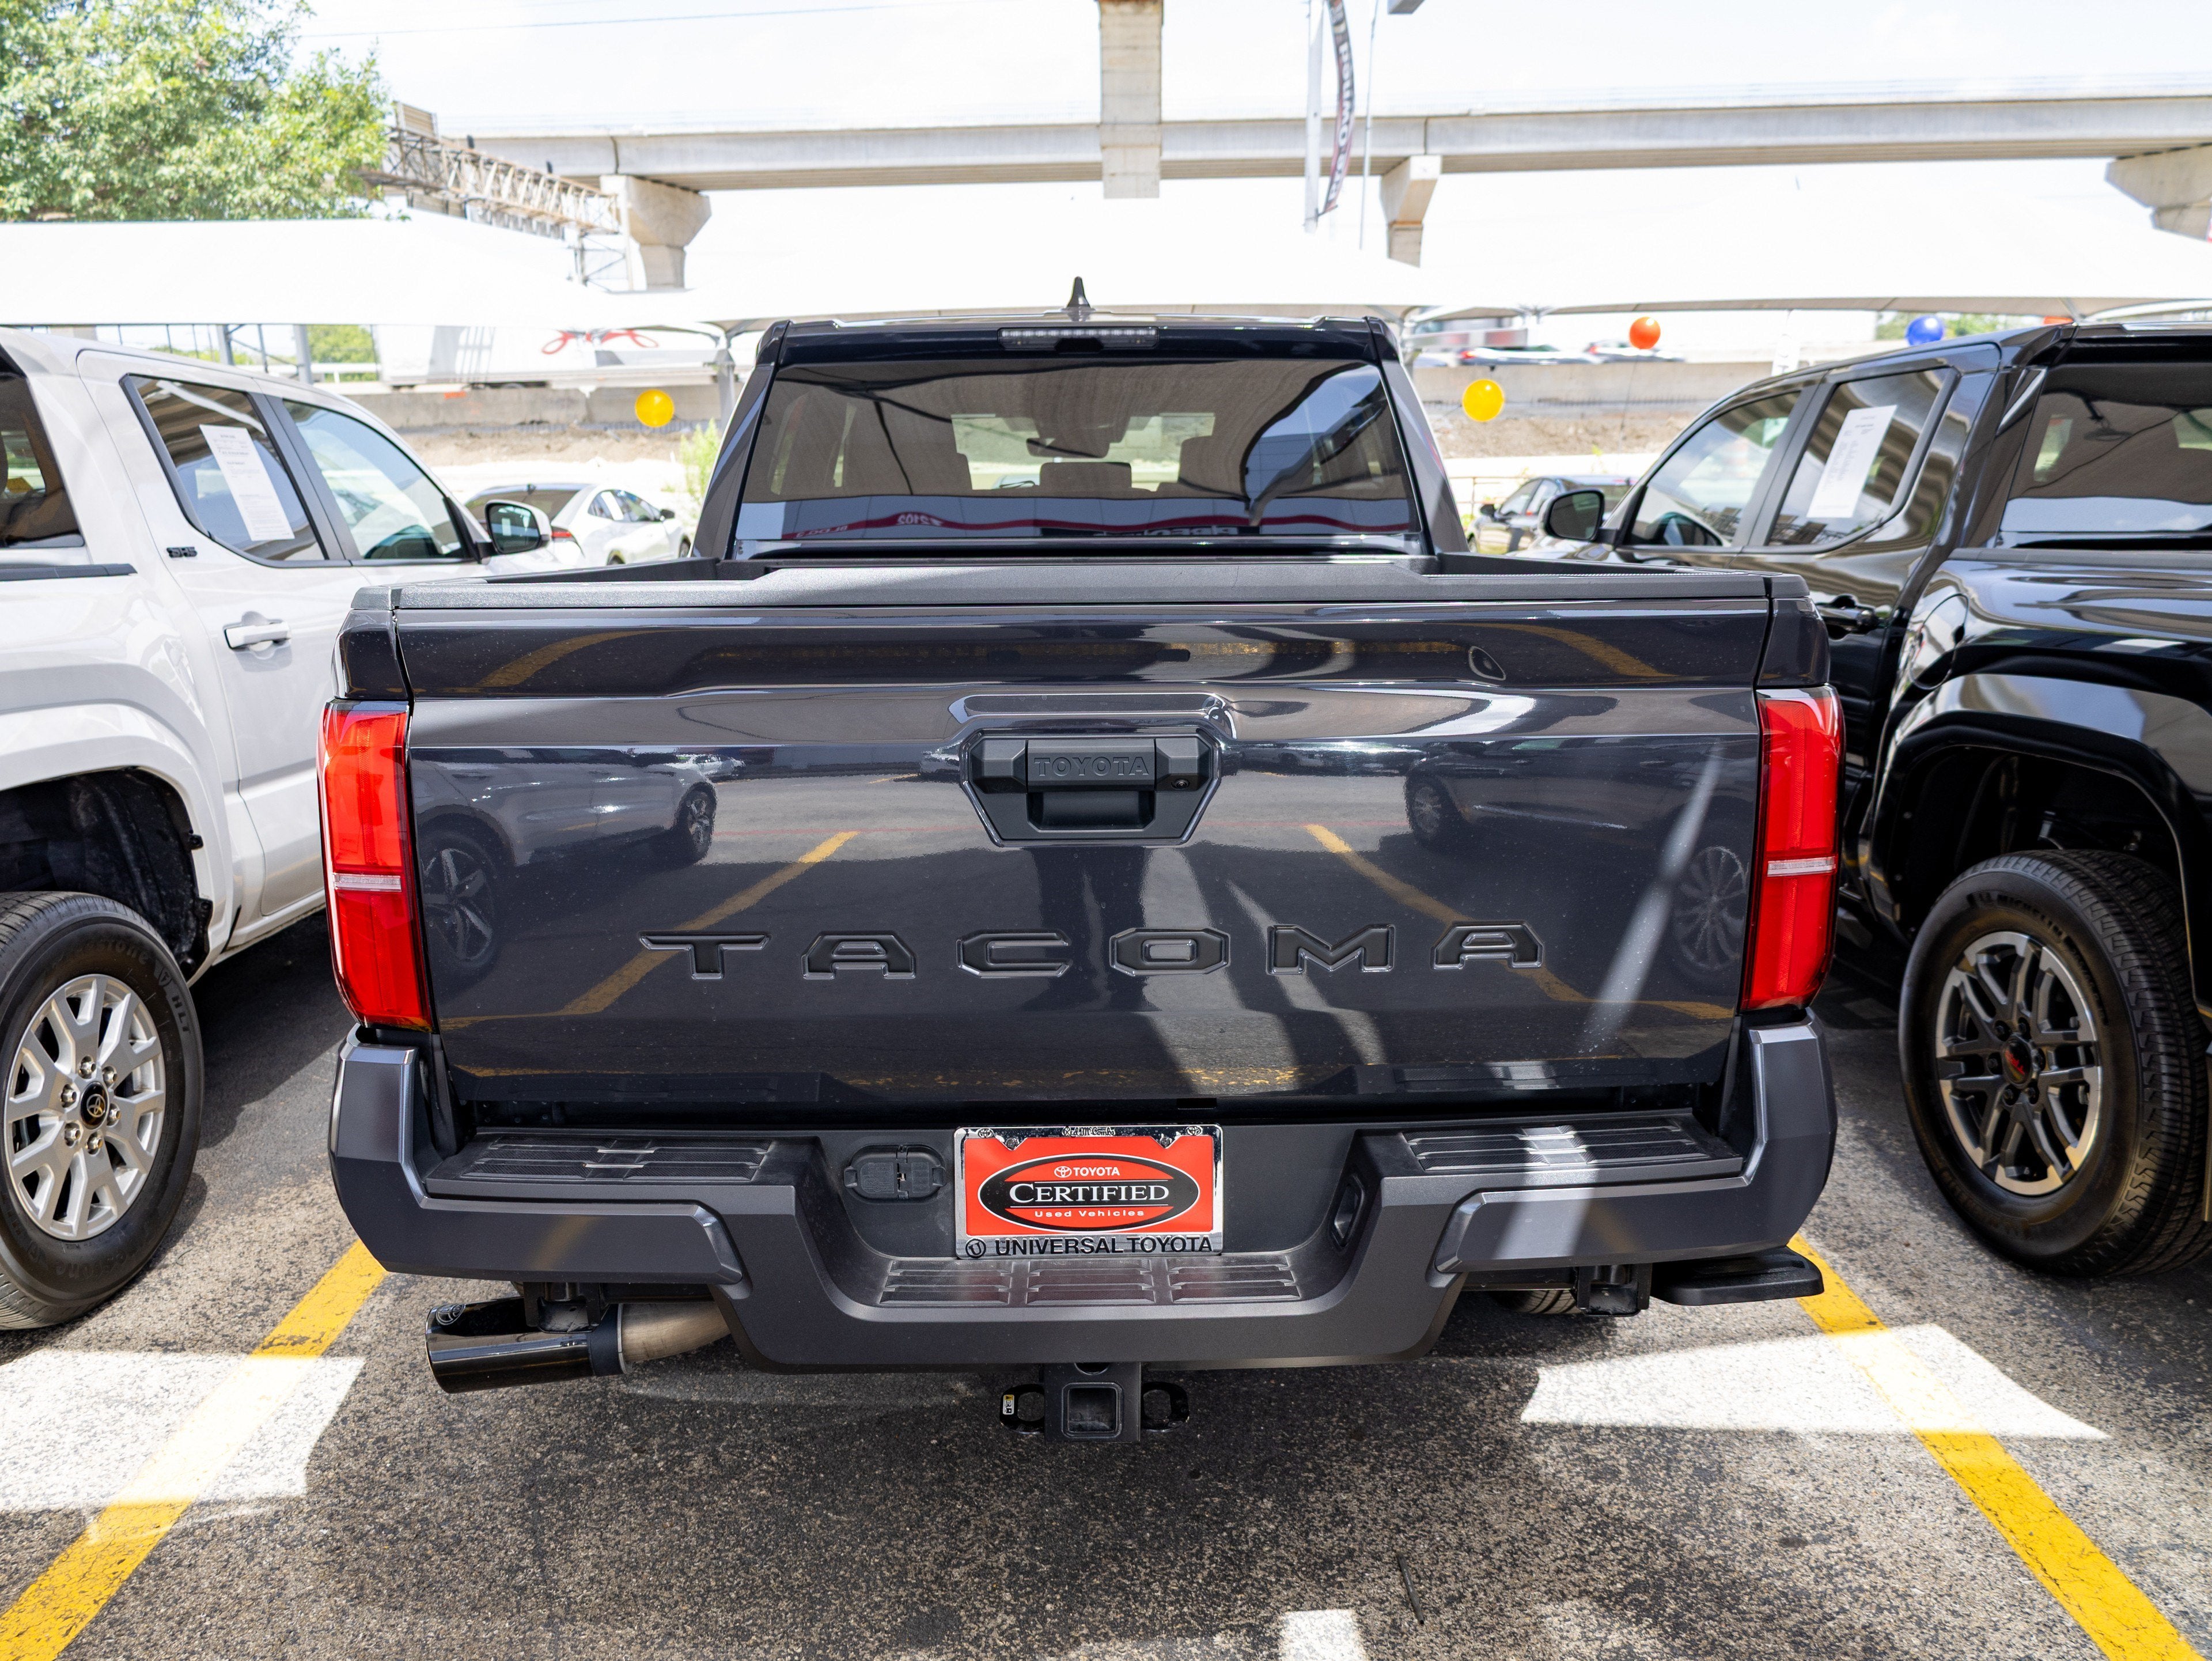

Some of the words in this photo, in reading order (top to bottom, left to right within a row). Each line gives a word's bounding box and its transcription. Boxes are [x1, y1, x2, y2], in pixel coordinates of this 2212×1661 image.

[1338, 41, 1353, 147] Owned
[1034, 756, 1149, 777] TOYOTA
[637, 921, 1545, 979] TACOMA
[1062, 1125, 1078, 1138] Red
[1073, 1166, 1120, 1176] TOYOTA
[1009, 1183, 1169, 1204] CERTIFIED
[1078, 1209, 1145, 1217] Vehicles
[995, 1237, 1124, 1256] UNIVERSAL
[1125, 1235, 1213, 1253] TOYOTA
